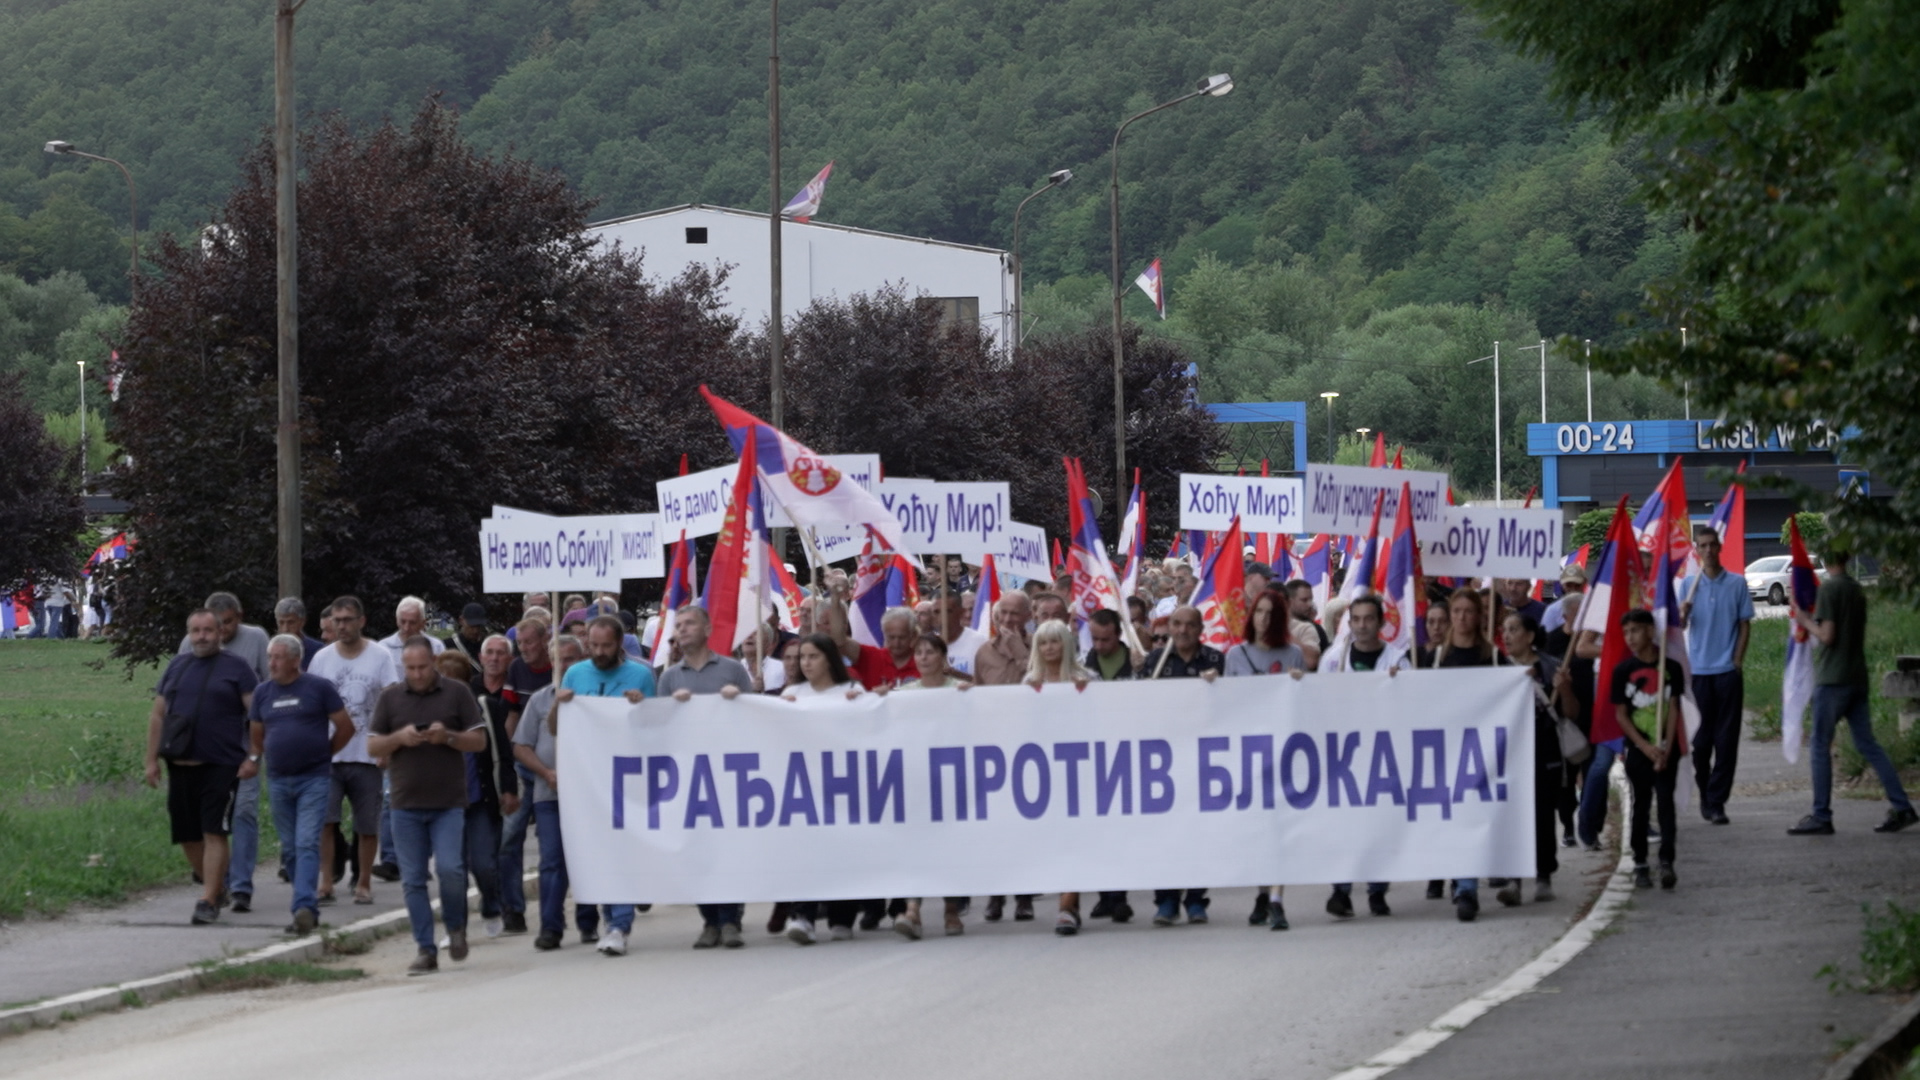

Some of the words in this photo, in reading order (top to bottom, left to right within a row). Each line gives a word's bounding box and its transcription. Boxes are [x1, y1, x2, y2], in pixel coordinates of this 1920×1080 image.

[1557, 423, 1634, 453] 00-24
[662, 491, 681, 524] Не
[685, 489, 718, 525] дамо
[947, 492, 1002, 543] Мир!
[1188, 482, 1240, 523] Хоћу
[1247, 485, 1296, 525] Мир!
[1312, 472, 1342, 527] Хоћу
[1408, 480, 1440, 523] ивот!
[487, 532, 508, 570] Не
[512, 541, 552, 576] дамо
[556, 529, 614, 577] Србију!
[620, 520, 656, 561] живот!
[1498, 517, 1555, 569] Мир!
[612, 748, 906, 831] ГРАЂАНИ
[929, 739, 1176, 823] ПРОТИВ
[1199, 727, 1508, 822] БЛОКАДА!
